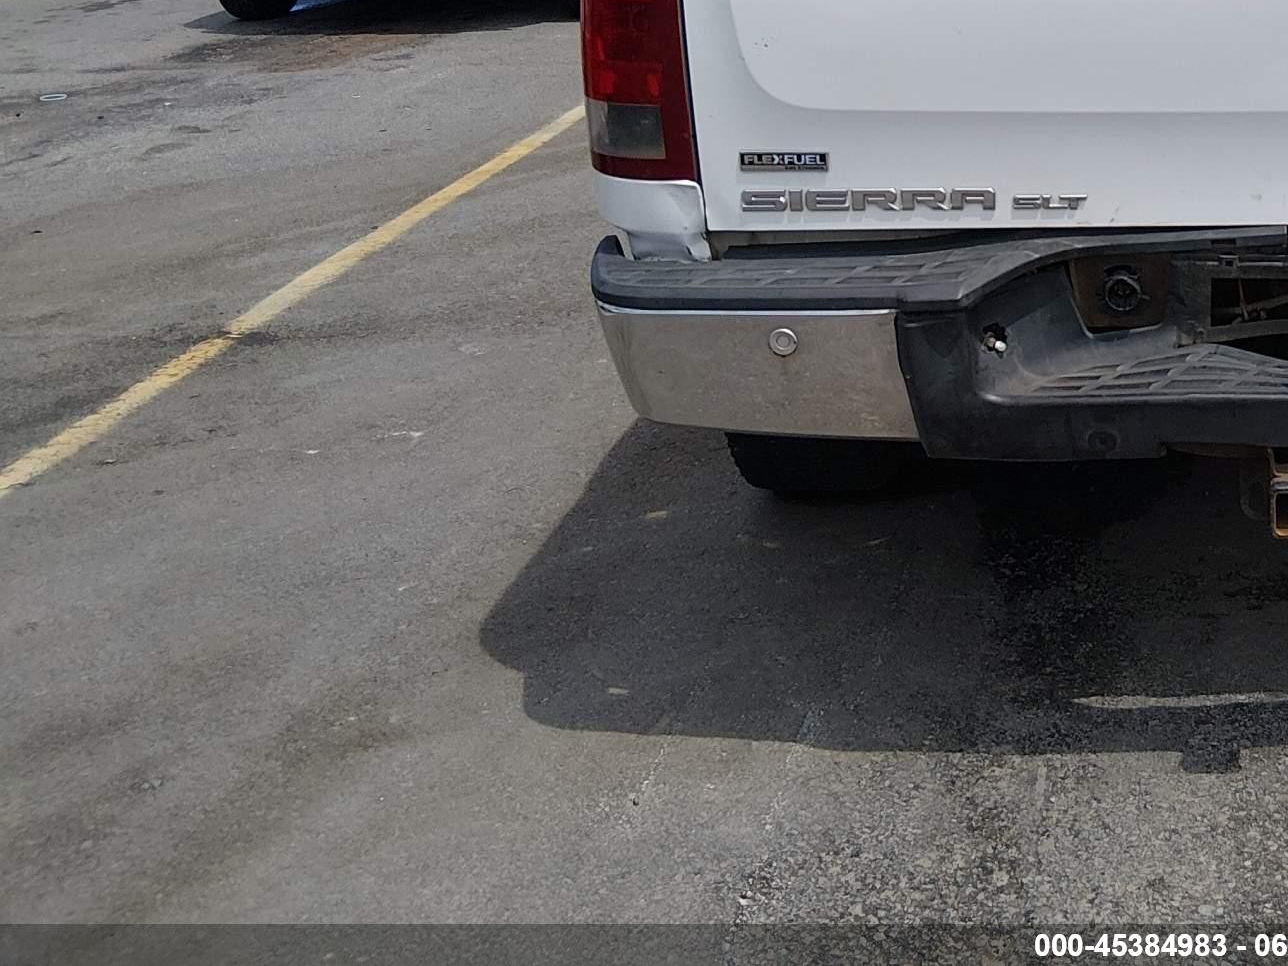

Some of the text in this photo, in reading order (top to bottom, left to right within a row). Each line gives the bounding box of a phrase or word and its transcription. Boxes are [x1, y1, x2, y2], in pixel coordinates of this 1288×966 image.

[743, 154, 825, 165] FLEXFUEL
[741, 189, 1088, 212] SIERRA SLT
